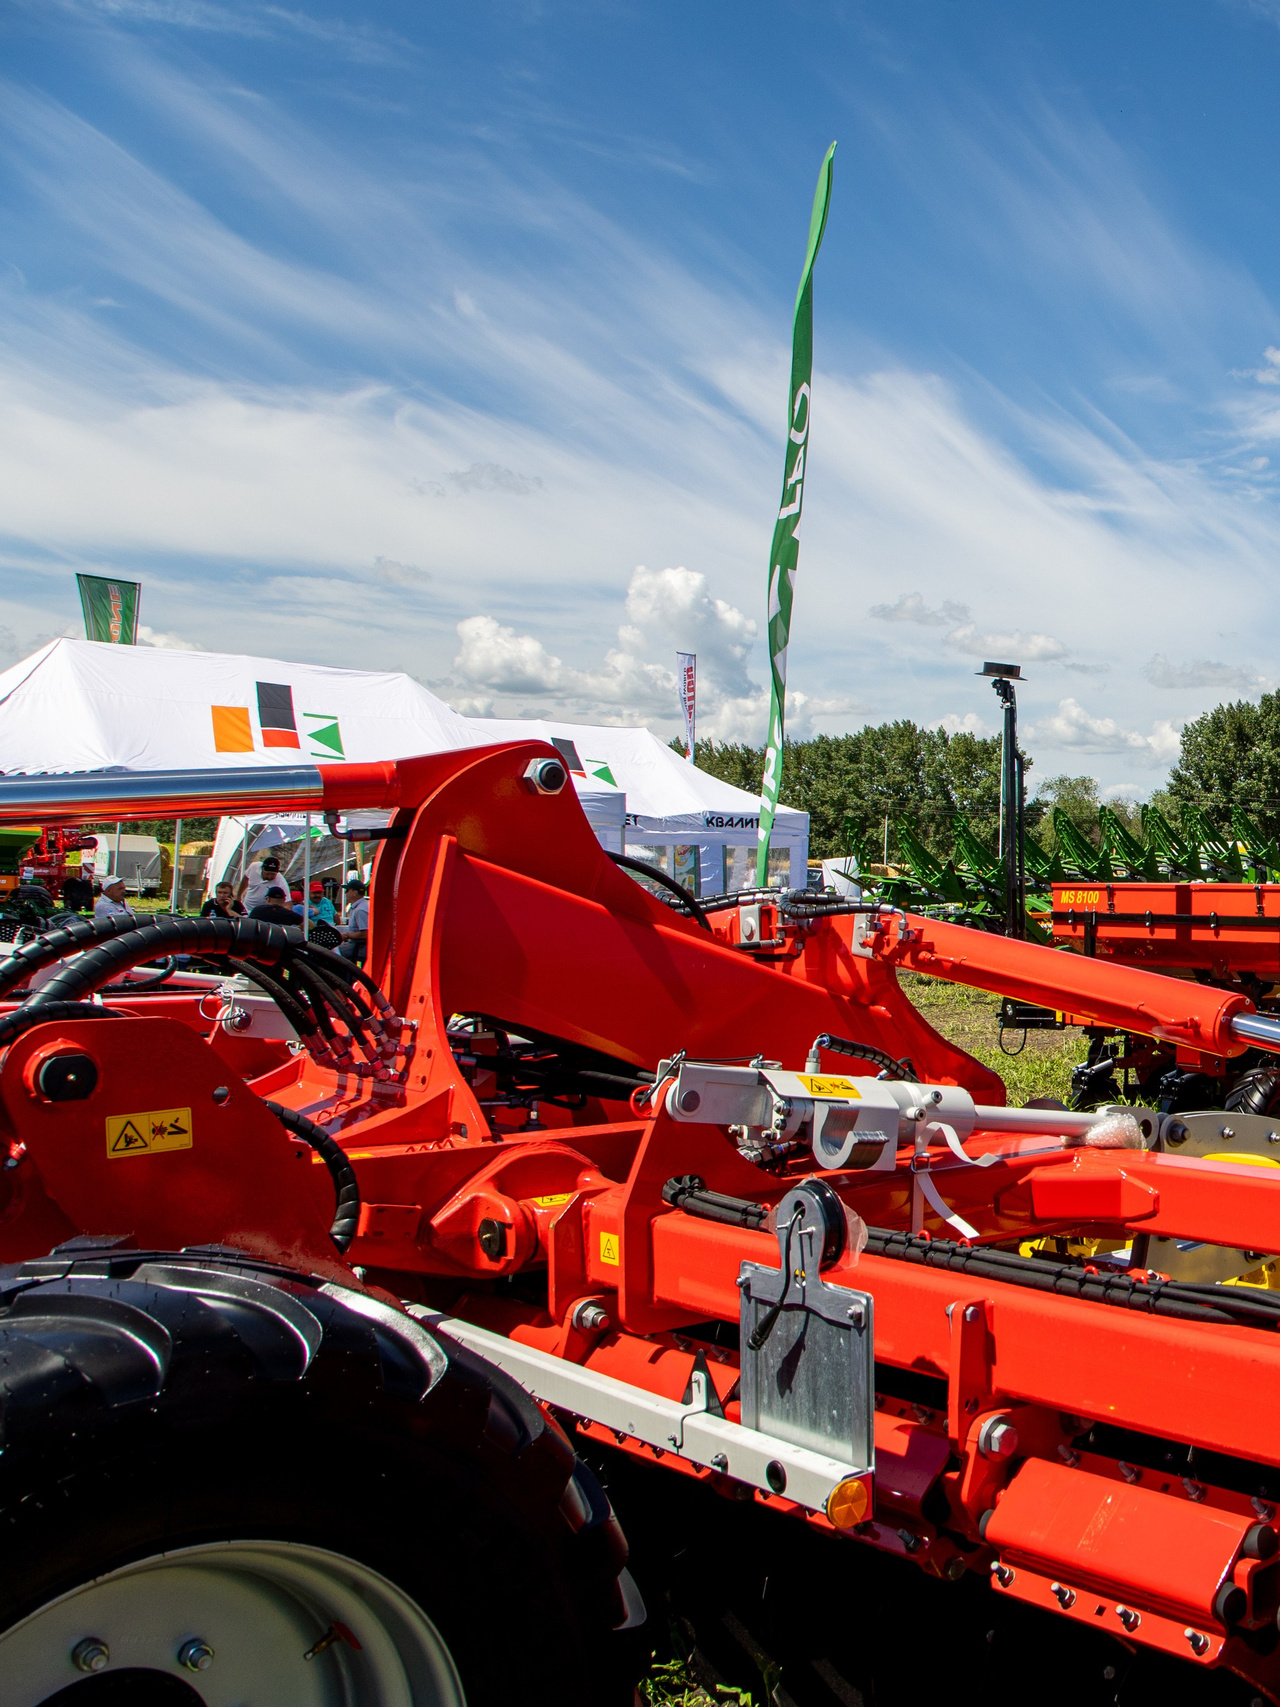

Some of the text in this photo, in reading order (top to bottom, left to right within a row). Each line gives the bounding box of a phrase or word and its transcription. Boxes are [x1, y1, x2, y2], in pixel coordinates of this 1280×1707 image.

[706, 816, 776, 829] КВАЛИТ
[1061, 891, 1100, 904] MS 8100
